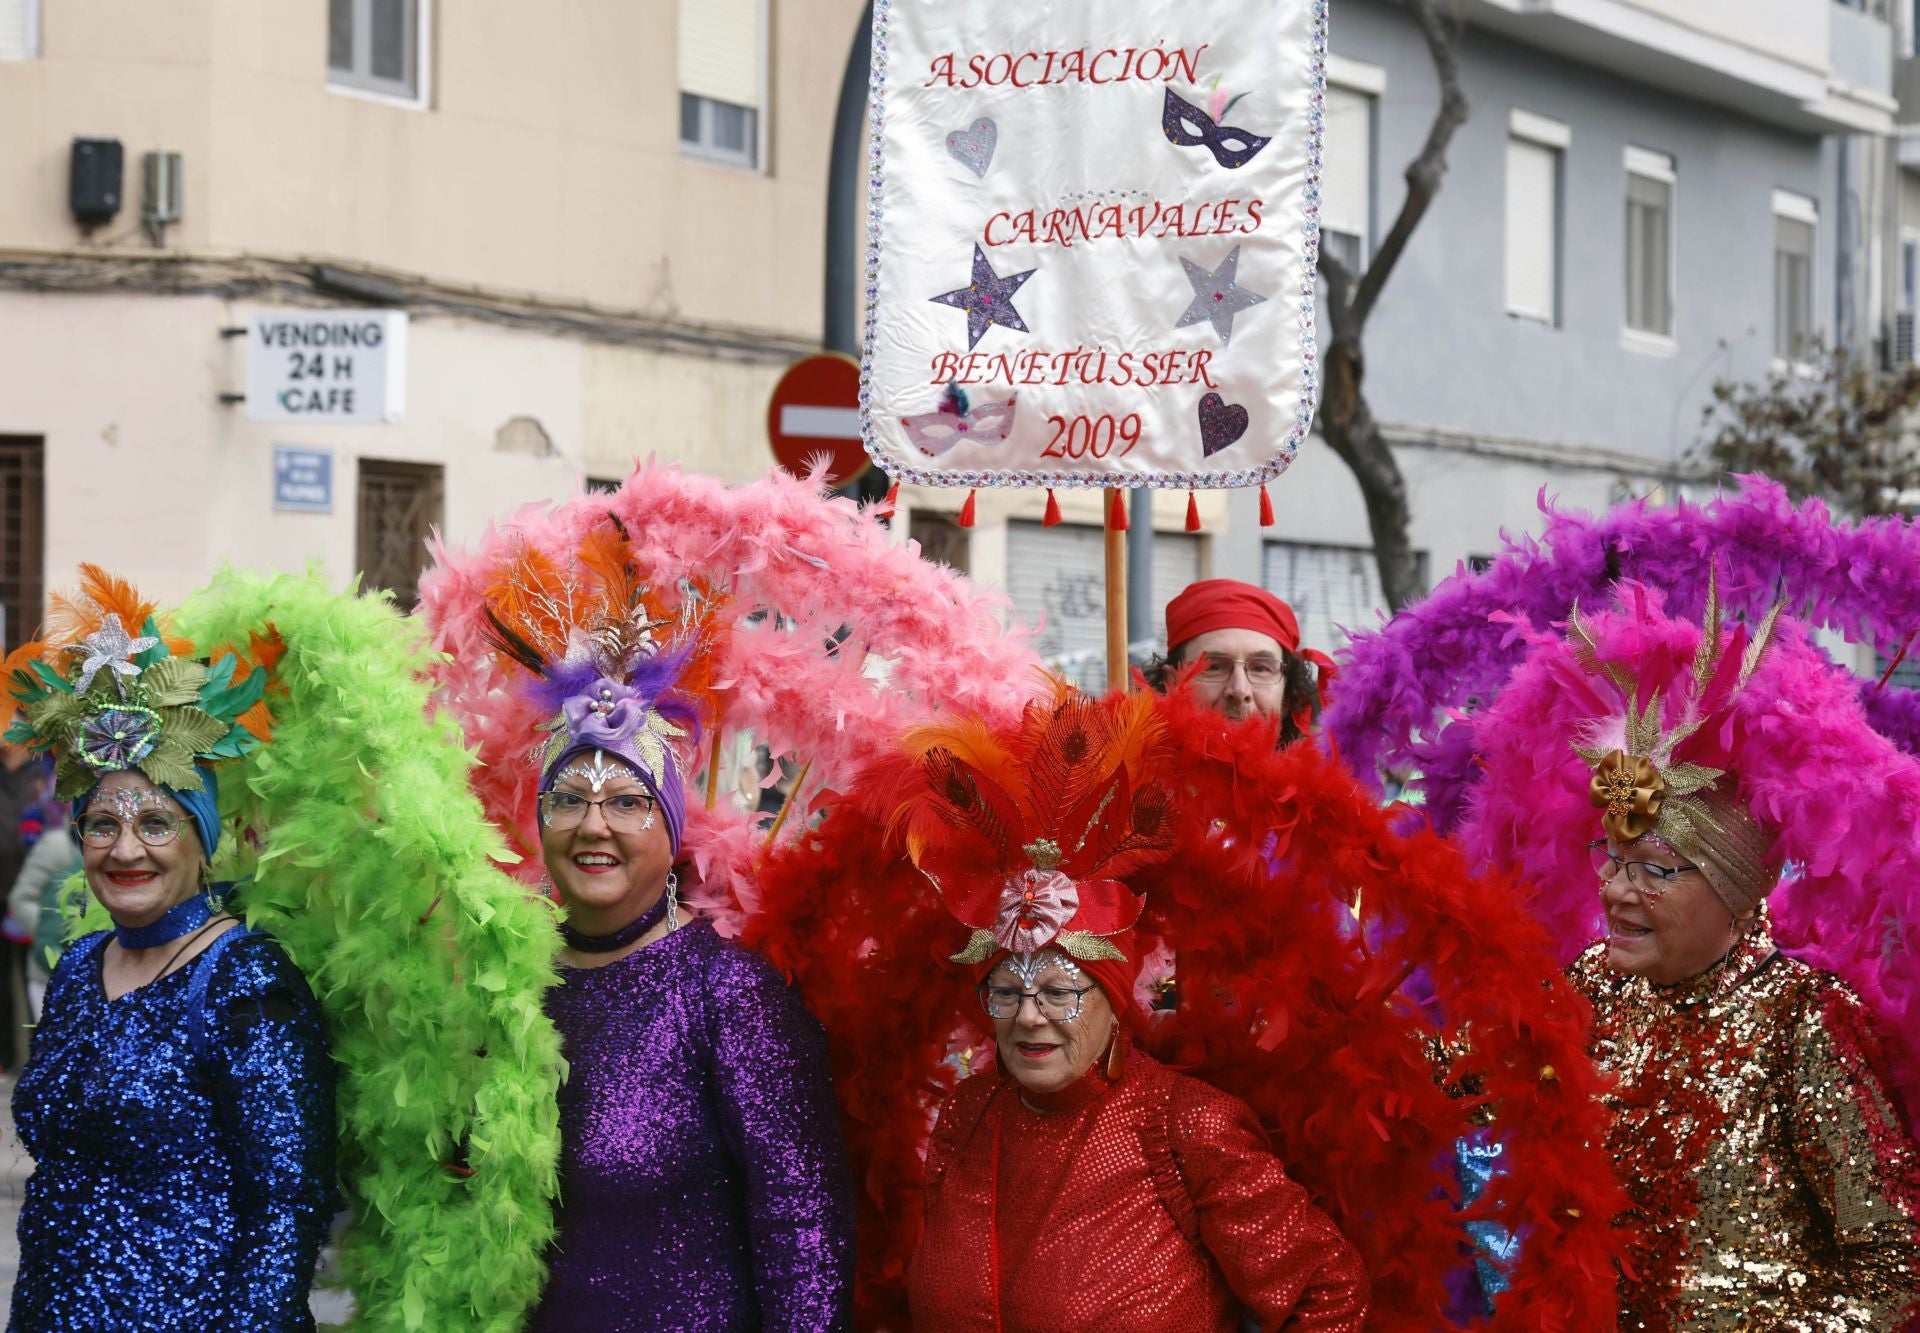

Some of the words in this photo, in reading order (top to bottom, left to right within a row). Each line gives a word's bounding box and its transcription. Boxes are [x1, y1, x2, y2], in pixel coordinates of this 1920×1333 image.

[925, 39, 1209, 88] ASOCIACIÓN
[984, 199, 1263, 247] CARNAVALES
[259, 322, 383, 348] VENDING
[288, 352, 324, 380] 24
[333, 356, 353, 379] H
[930, 345, 1219, 389] BENETÚSSER
[283, 388, 354, 413] CAFE
[1040, 413, 1142, 460] 2009
